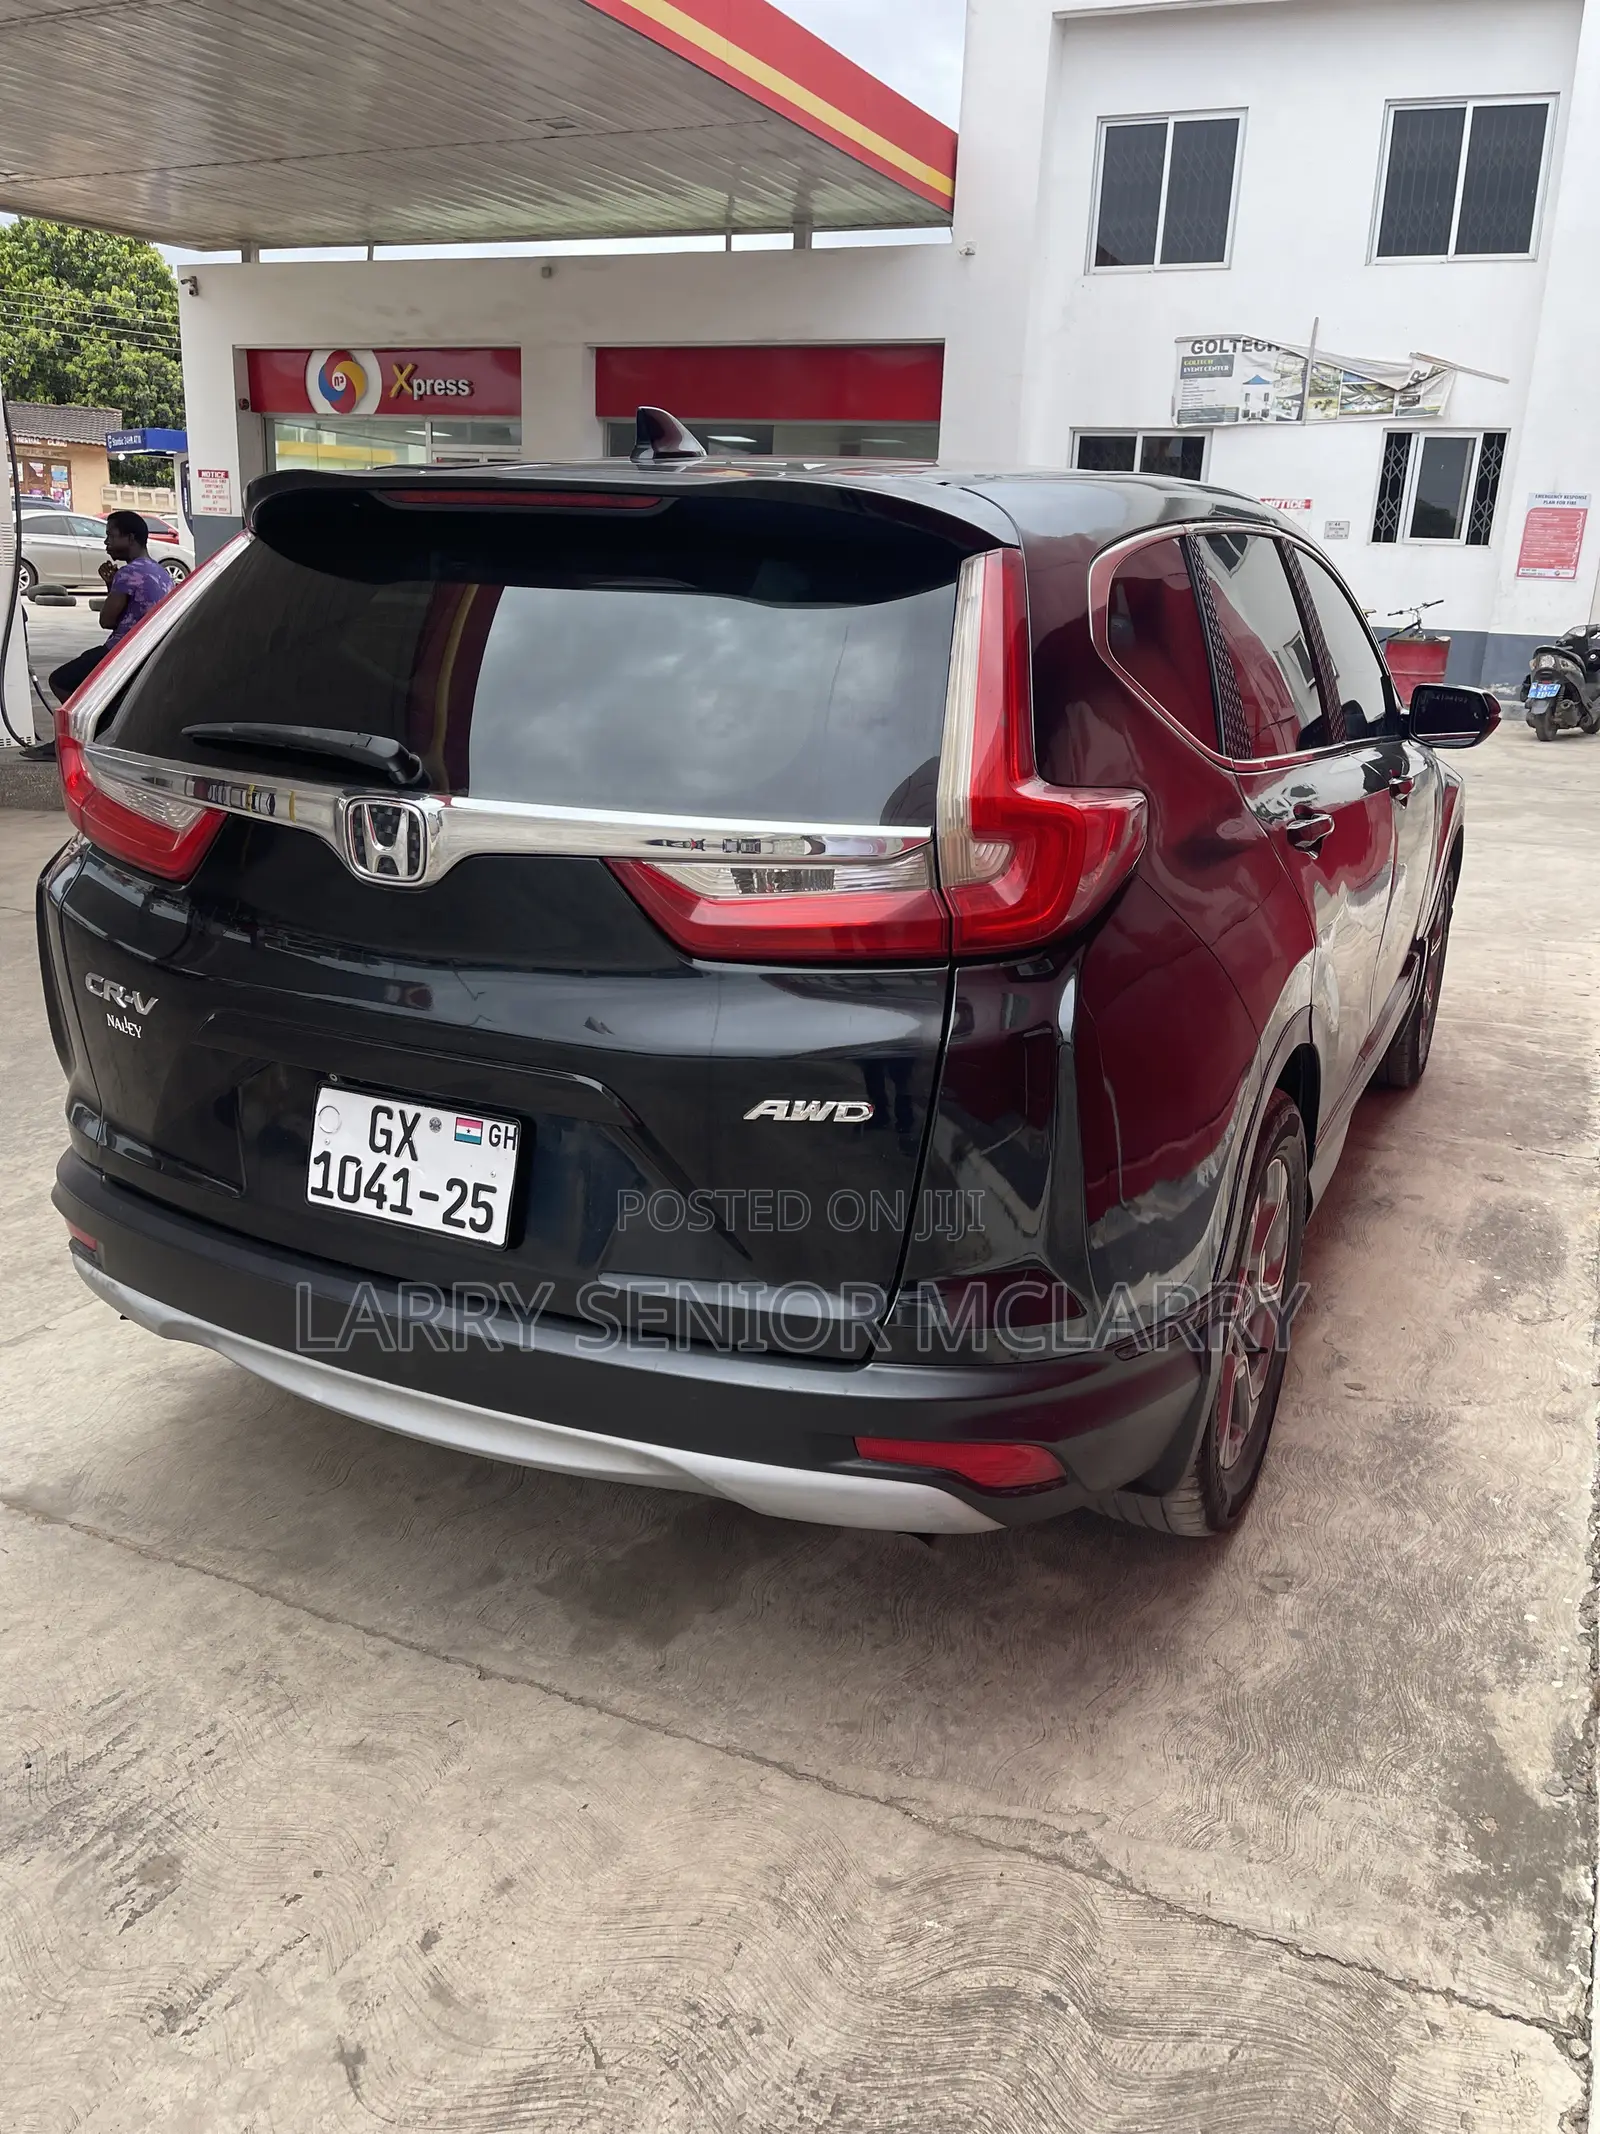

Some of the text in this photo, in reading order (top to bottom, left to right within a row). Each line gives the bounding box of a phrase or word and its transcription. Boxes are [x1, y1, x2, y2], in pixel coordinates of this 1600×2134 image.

[389, 363, 471, 400] Xpress
[201, 471, 226, 479] NOTICE
[85, 972, 159, 1016] CR-V
[106, 1013, 142, 1039] NALLEY
[743, 1099, 875, 1122] AWD
[369, 1105, 518, 1161] GX GH
[310, 1150, 498, 1233] 1041-25
